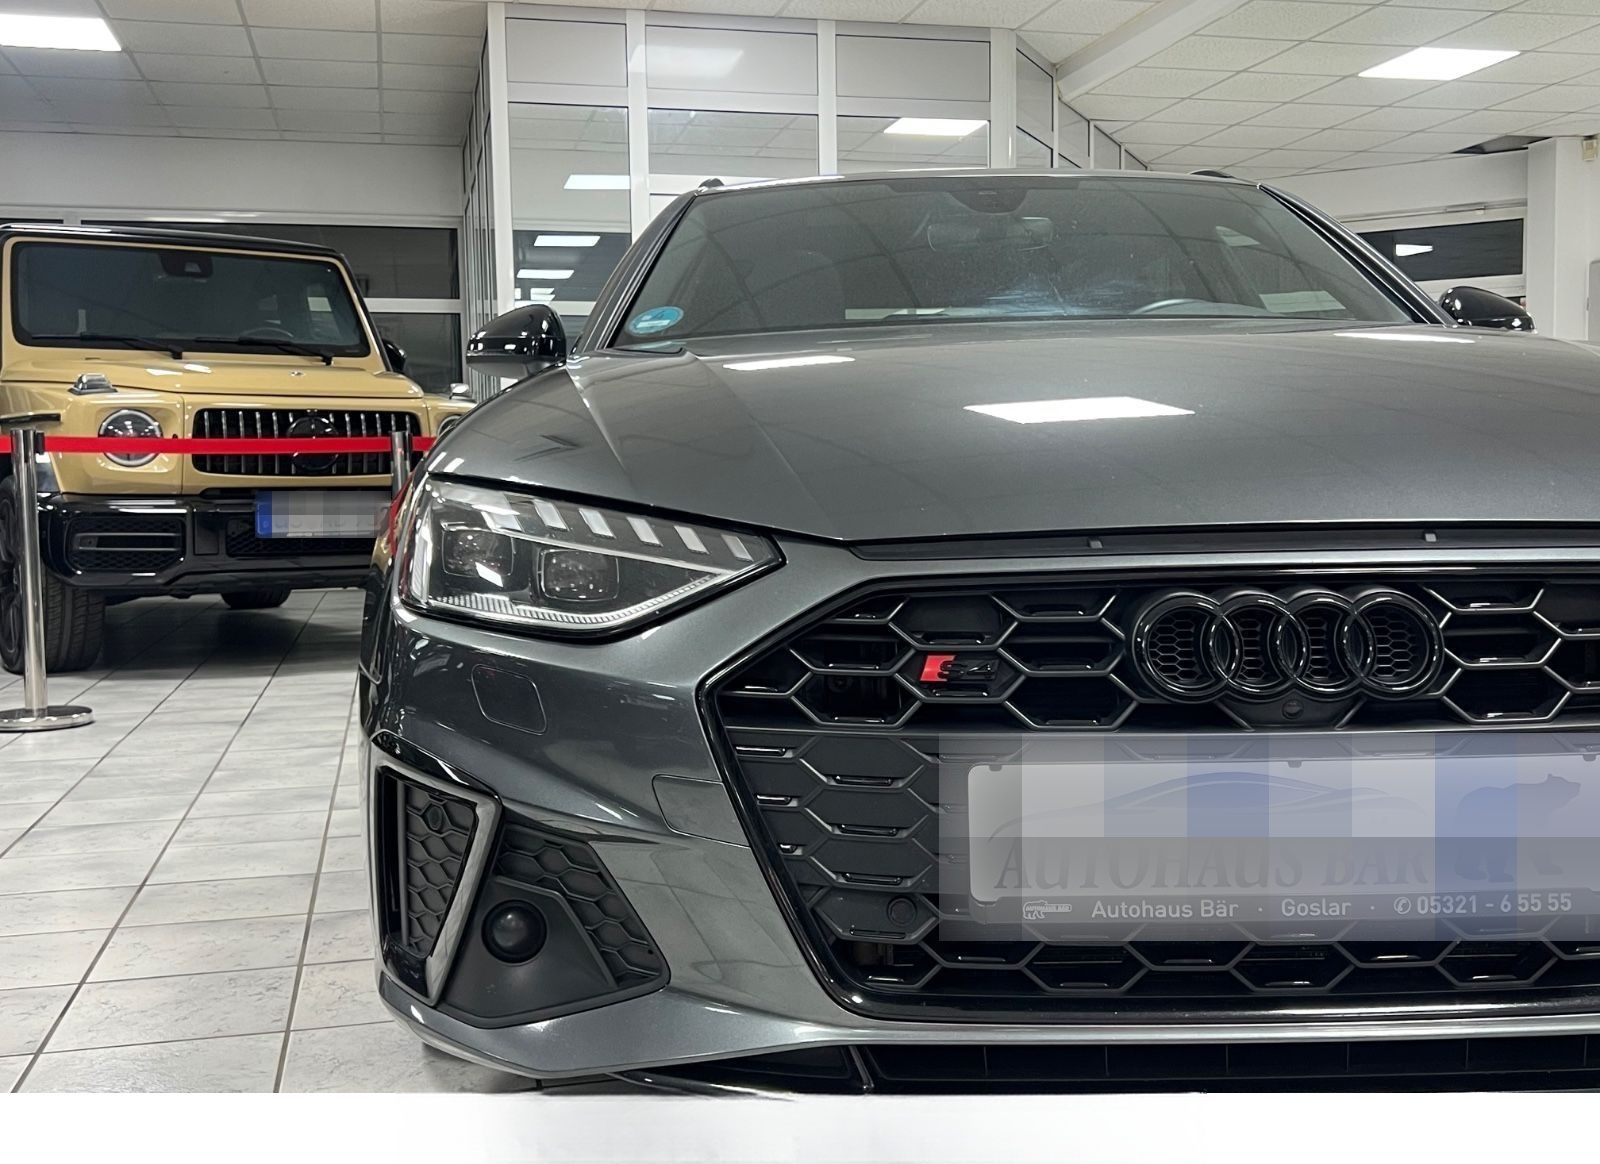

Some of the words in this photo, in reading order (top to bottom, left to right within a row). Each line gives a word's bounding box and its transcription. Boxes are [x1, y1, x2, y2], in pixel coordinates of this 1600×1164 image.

[993, 837, 1303, 890] AUTOHAUS
[1091, 900, 1193, 918] Autohaus
[1200, 899, 1239, 918] Bär
[1281, 898, 1351, 916] Goslar
[1416, 896, 1477, 914] 05321
